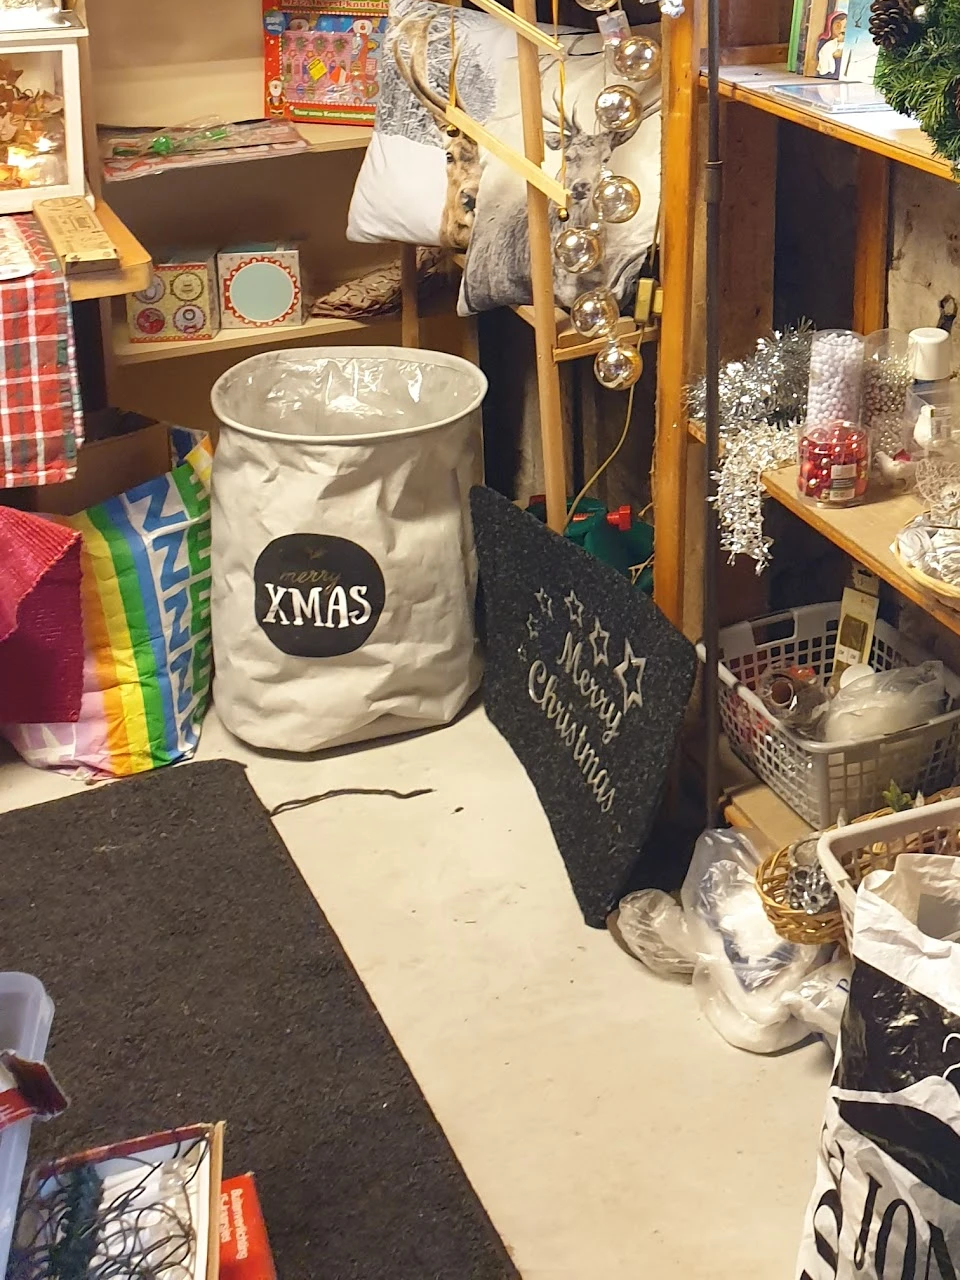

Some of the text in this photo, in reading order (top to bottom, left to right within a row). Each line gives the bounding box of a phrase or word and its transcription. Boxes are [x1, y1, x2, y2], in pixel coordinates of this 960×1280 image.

[262, 583, 372, 628] XMAS
[528, 659, 617, 813] Christmas
[556, 631, 623, 745] Merry
